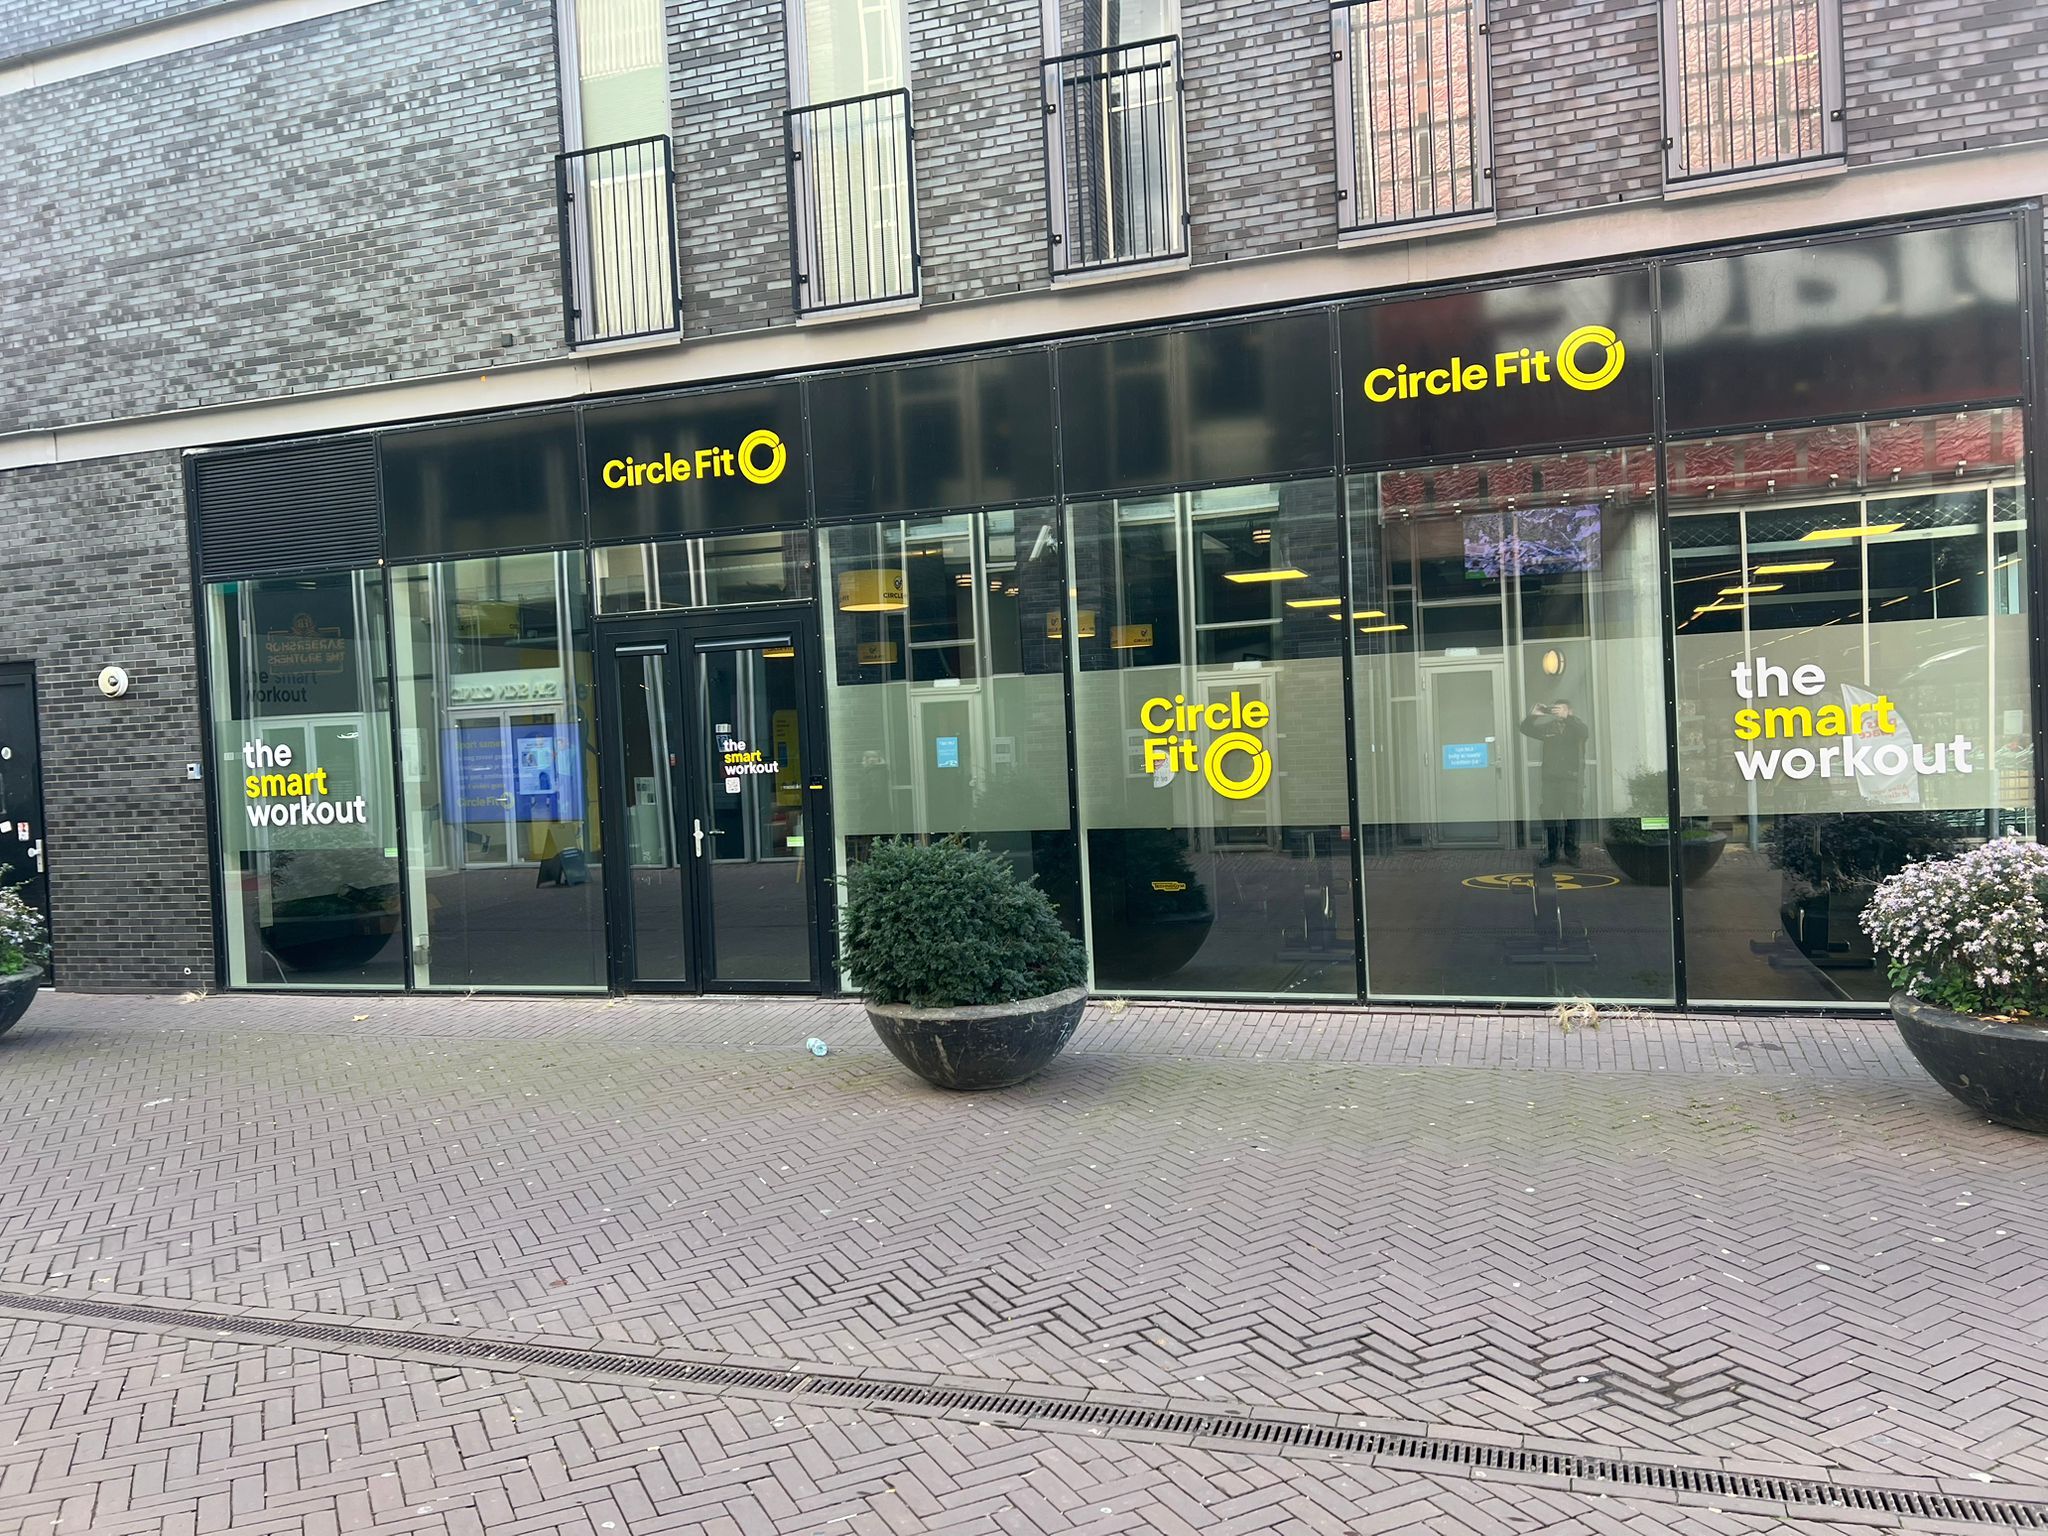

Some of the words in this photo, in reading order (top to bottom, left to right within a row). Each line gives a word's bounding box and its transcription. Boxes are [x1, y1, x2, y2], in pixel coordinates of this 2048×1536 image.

[1364, 358, 1489, 404] Circle
[1496, 349, 1551, 388] Fit
[603, 452, 692, 490] Circle
[695, 447, 735, 479] Fit
[1731, 654, 1827, 700] the
[1140, 690, 1271, 734] Circle
[1734, 694, 1897, 742] smart
[242, 738, 293, 769] the
[723, 738, 747, 753] the
[724, 750, 762, 765] smart
[1144, 735, 1199, 774] Fit
[1733, 730, 1974, 786] workout
[245, 766, 329, 800] smart
[724, 760, 779, 777] workout
[245, 793, 367, 828] workout
